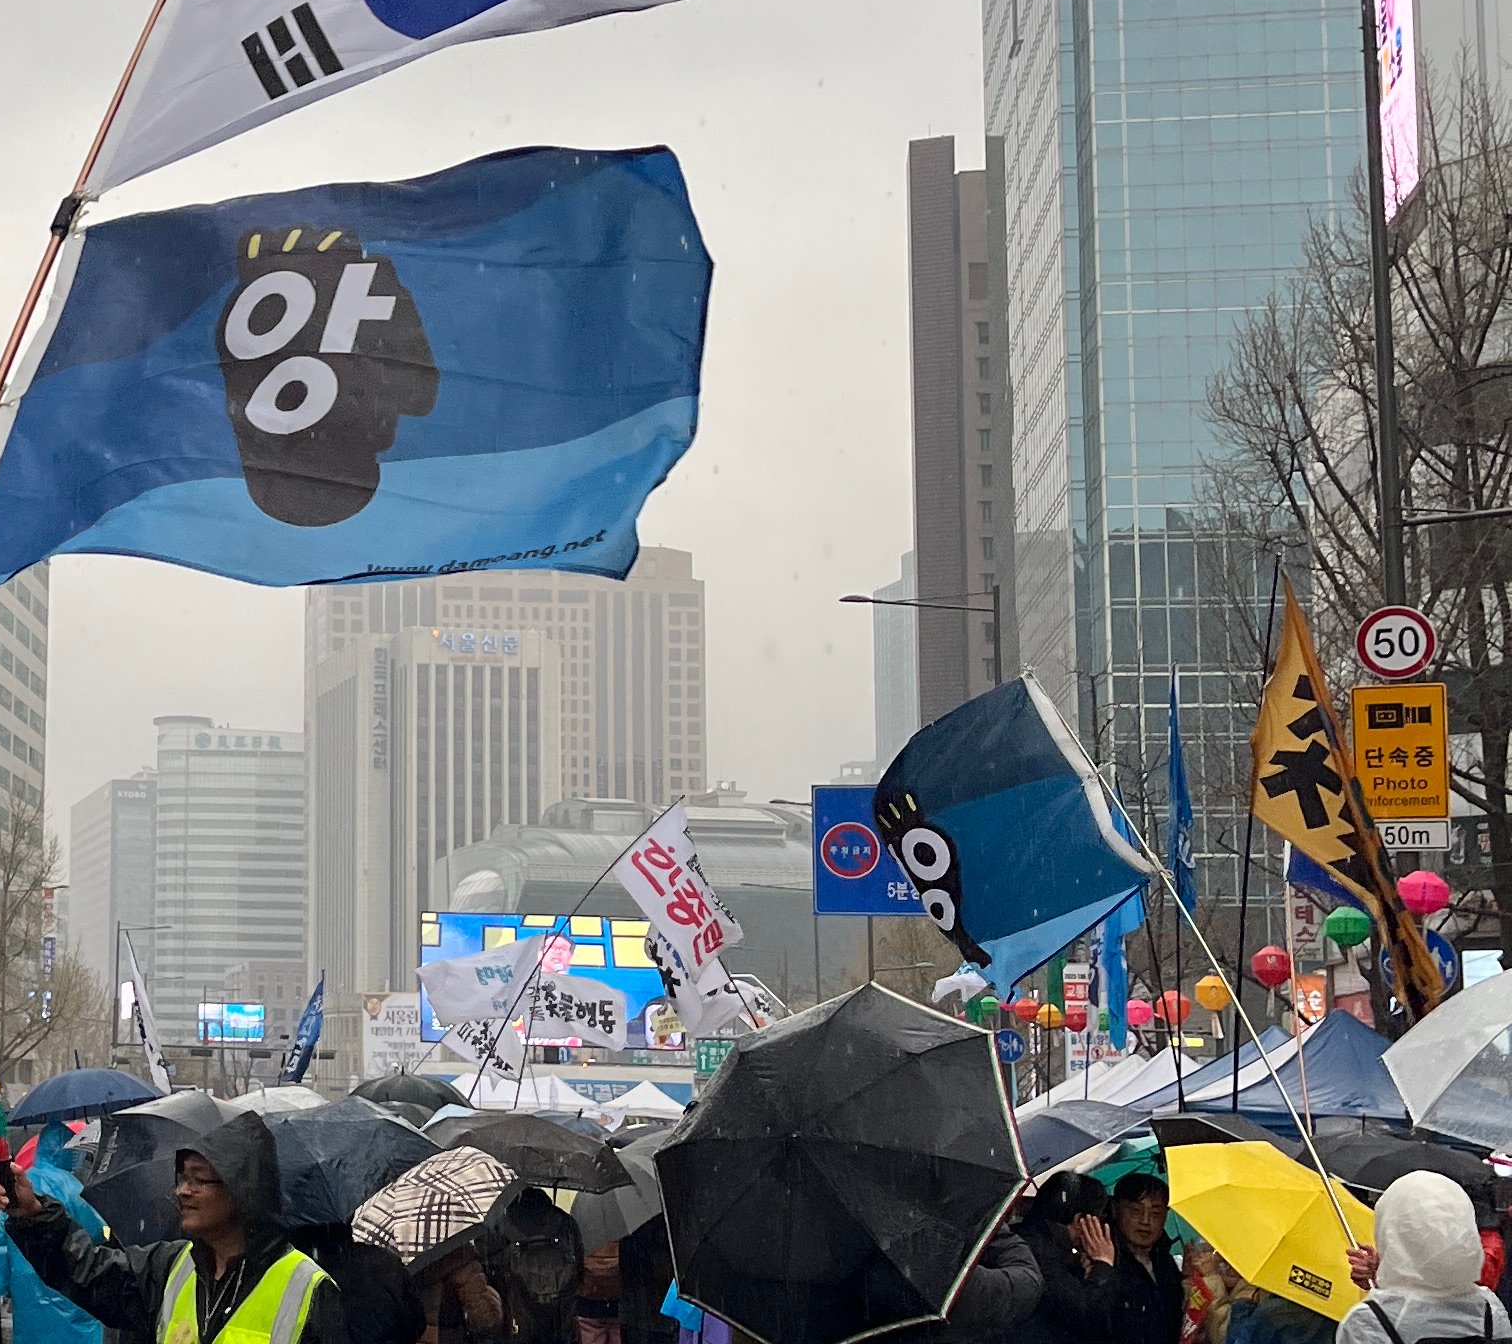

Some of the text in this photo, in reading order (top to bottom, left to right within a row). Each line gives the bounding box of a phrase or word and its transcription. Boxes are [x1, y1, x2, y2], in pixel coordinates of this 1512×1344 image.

[225, 262, 396, 435] 앙
[440, 632, 519, 655] 서울신문
[1374, 626, 1420, 658] 50
[1365, 745, 1435, 768] 단속중
[1373, 776, 1428, 791] Photo
[1366, 794, 1441, 807] nforcement
